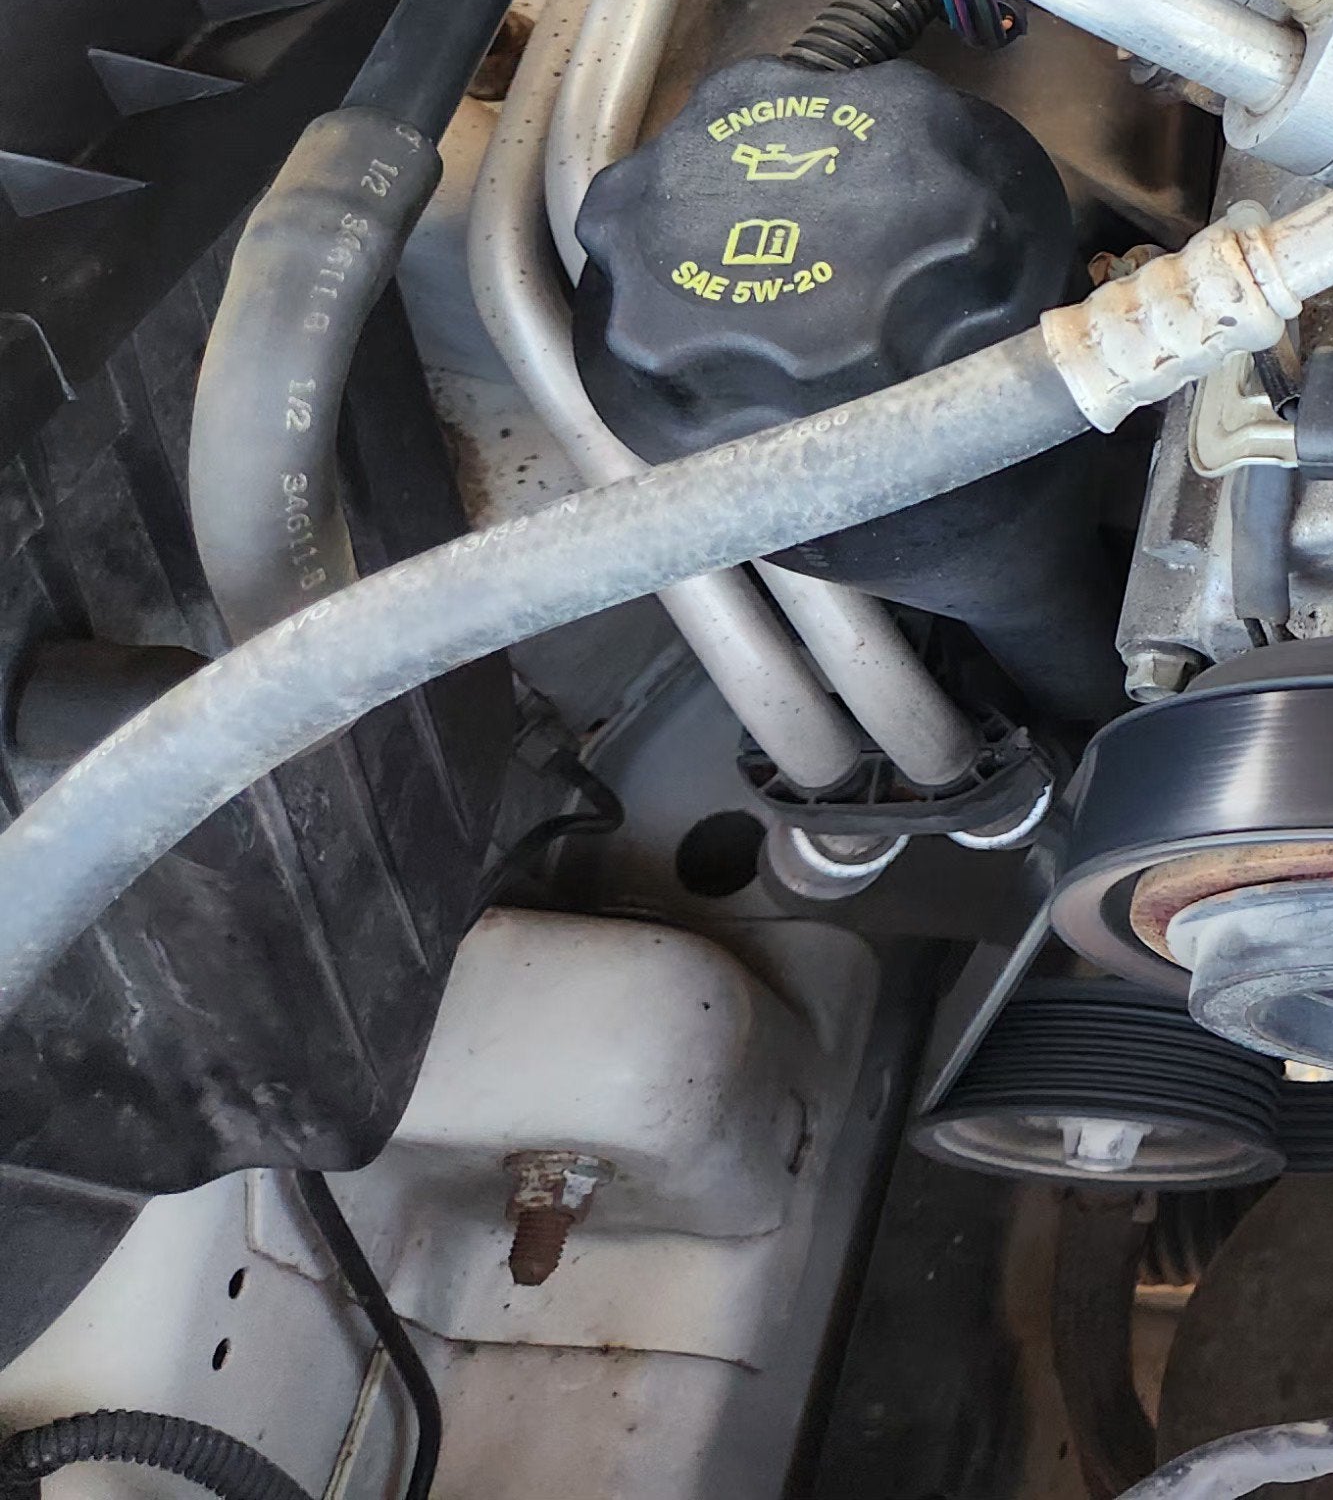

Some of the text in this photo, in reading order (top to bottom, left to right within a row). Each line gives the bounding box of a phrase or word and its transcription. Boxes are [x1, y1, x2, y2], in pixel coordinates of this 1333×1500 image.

[707, 96, 876, 142] ENGINE OIL
[671, 258, 833, 304] SAE 5W-20
